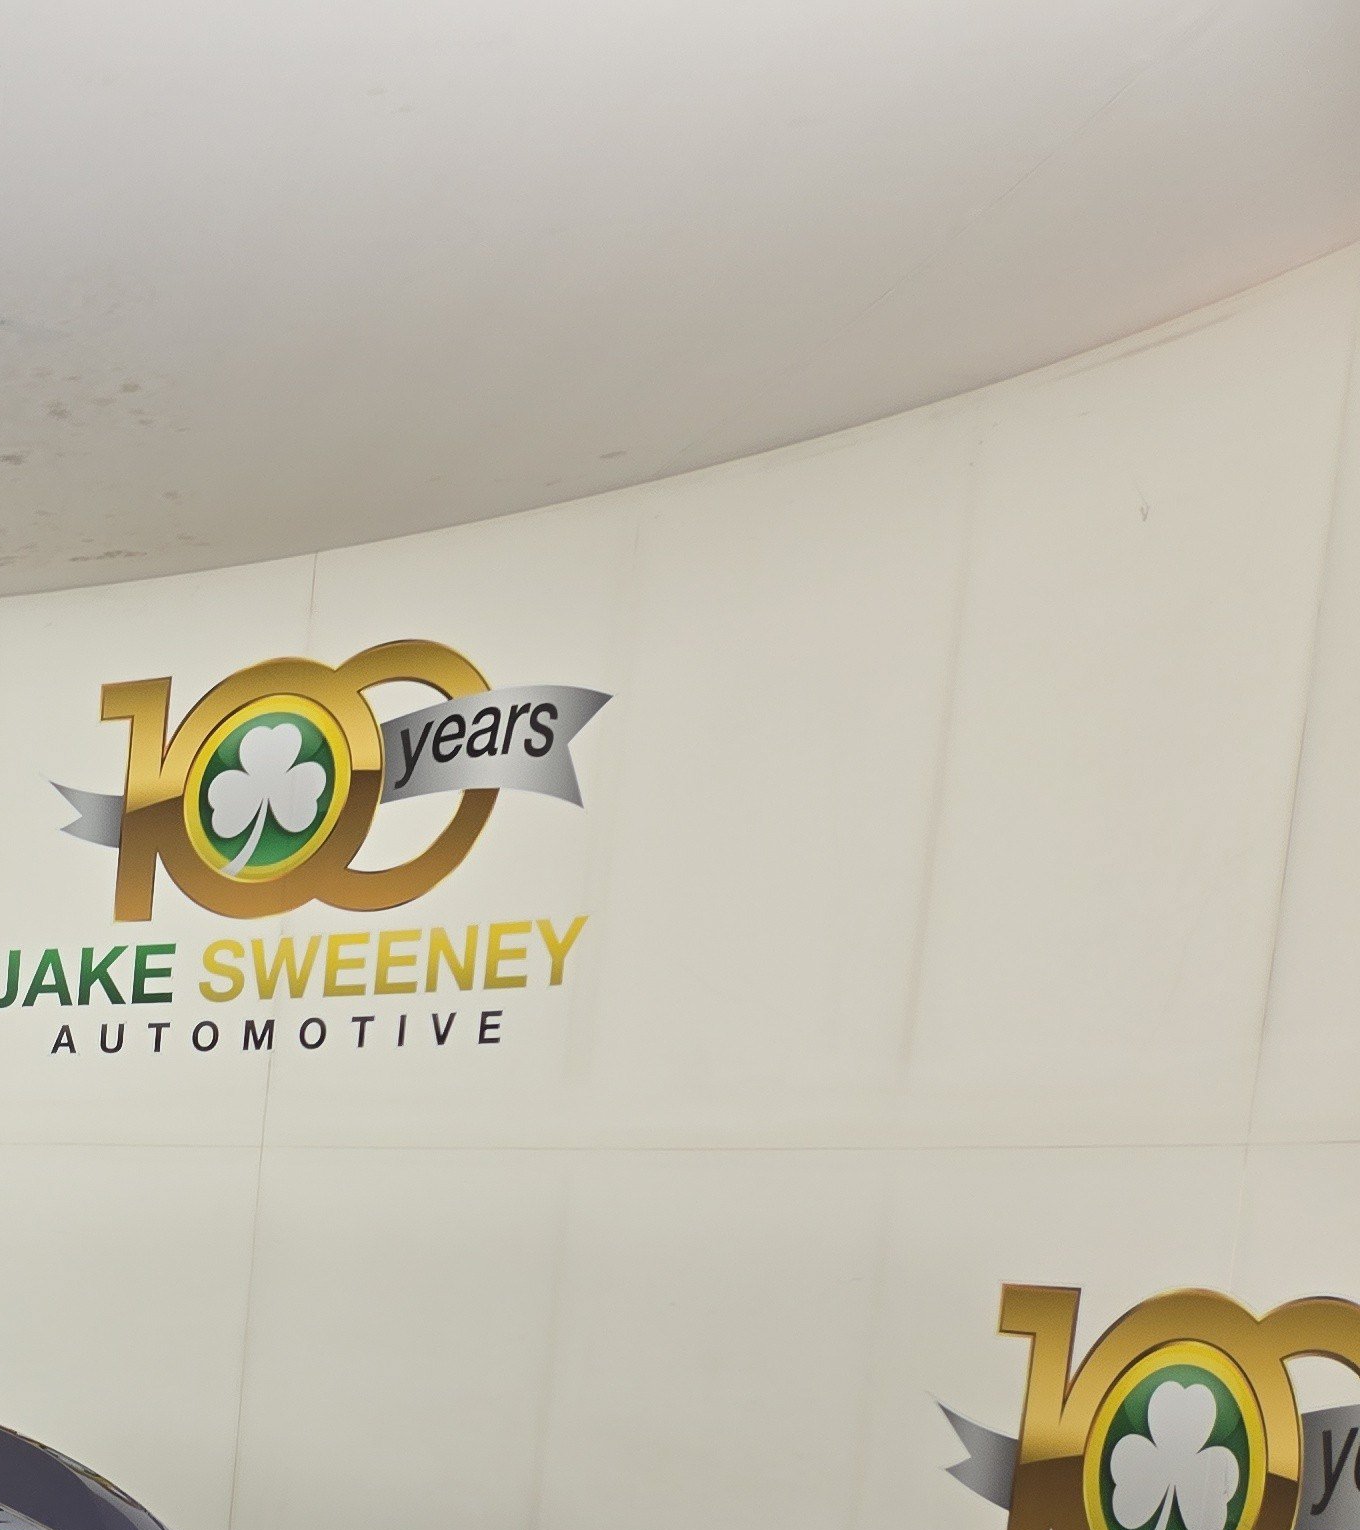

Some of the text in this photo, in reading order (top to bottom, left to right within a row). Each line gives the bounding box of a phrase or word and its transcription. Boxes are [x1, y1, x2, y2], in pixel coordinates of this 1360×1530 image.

[393, 700, 558, 789] years
[197, 915, 589, 1004] SWEENEY
[50, 1010, 503, 1055] AUTOMOTIVE
